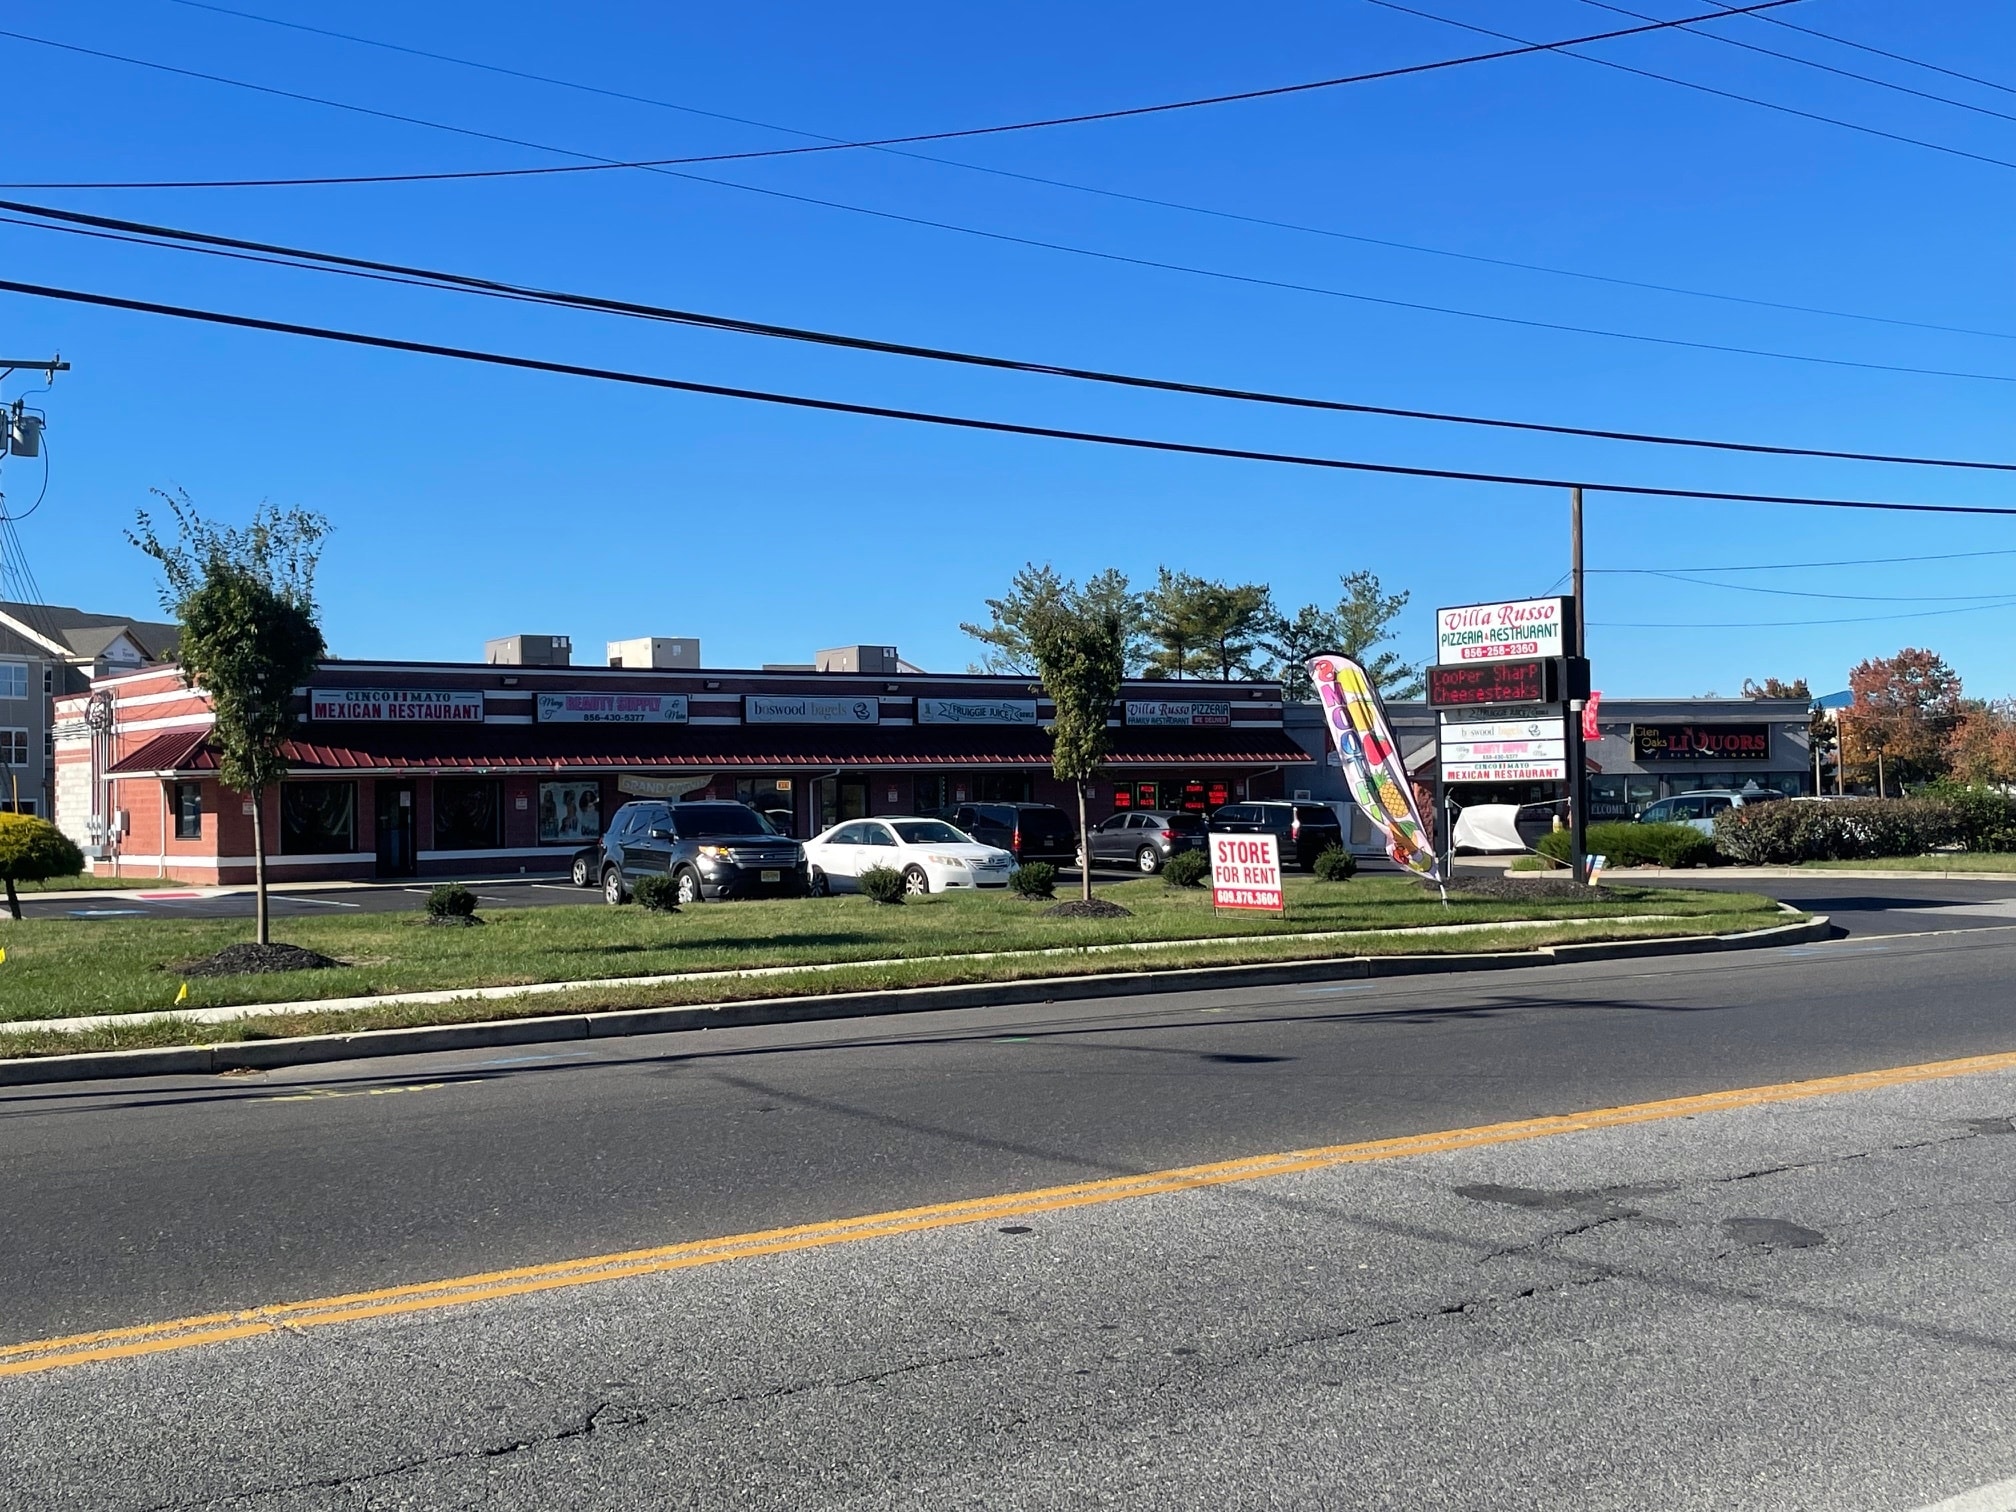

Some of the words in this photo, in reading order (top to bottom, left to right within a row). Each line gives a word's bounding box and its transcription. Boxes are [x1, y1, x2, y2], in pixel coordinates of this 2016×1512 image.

[1444, 609, 1491, 630] Villa
[1498, 606, 1555, 629] Russo
[1441, 630, 1484, 647] PIZZERIA
[1490, 623, 1559, 642] RESTAURANT
[1464, 643, 1536, 658] 856-258-2360
[345, 691, 391, 701] CINCO
[410, 692, 451, 702] MAYO
[565, 696, 615, 711] BEAUTY
[617, 697, 662, 712] SUPPLY
[314, 702, 382, 719] MEXICAN
[388, 704, 480, 719] RESTAURANT
[754, 701, 806, 716] boswood
[1127, 703, 1156, 716] Villa
[1159, 703, 1190, 717] Russo
[1191, 704, 1229, 715] PIZZERIA
[583, 713, 645, 722] 856-430-5377
[1461, 726, 1495, 737] bswood
[1635, 727, 1659, 737] Glen
[1641, 736, 1668, 747] Oaks
[1668, 731, 1766, 755] LIQUORS
[1447, 770, 1490, 780] MEXICAN
[1494, 769, 1560, 779] RESTAURANT
[1590, 804, 1625, 815] ELCOME
[1218, 841, 1271, 864] STORE
[1216, 866, 1240, 883] FOR
[1244, 867, 1276, 884] RENT
[1217, 890, 1280, 906] 609.876.3604
